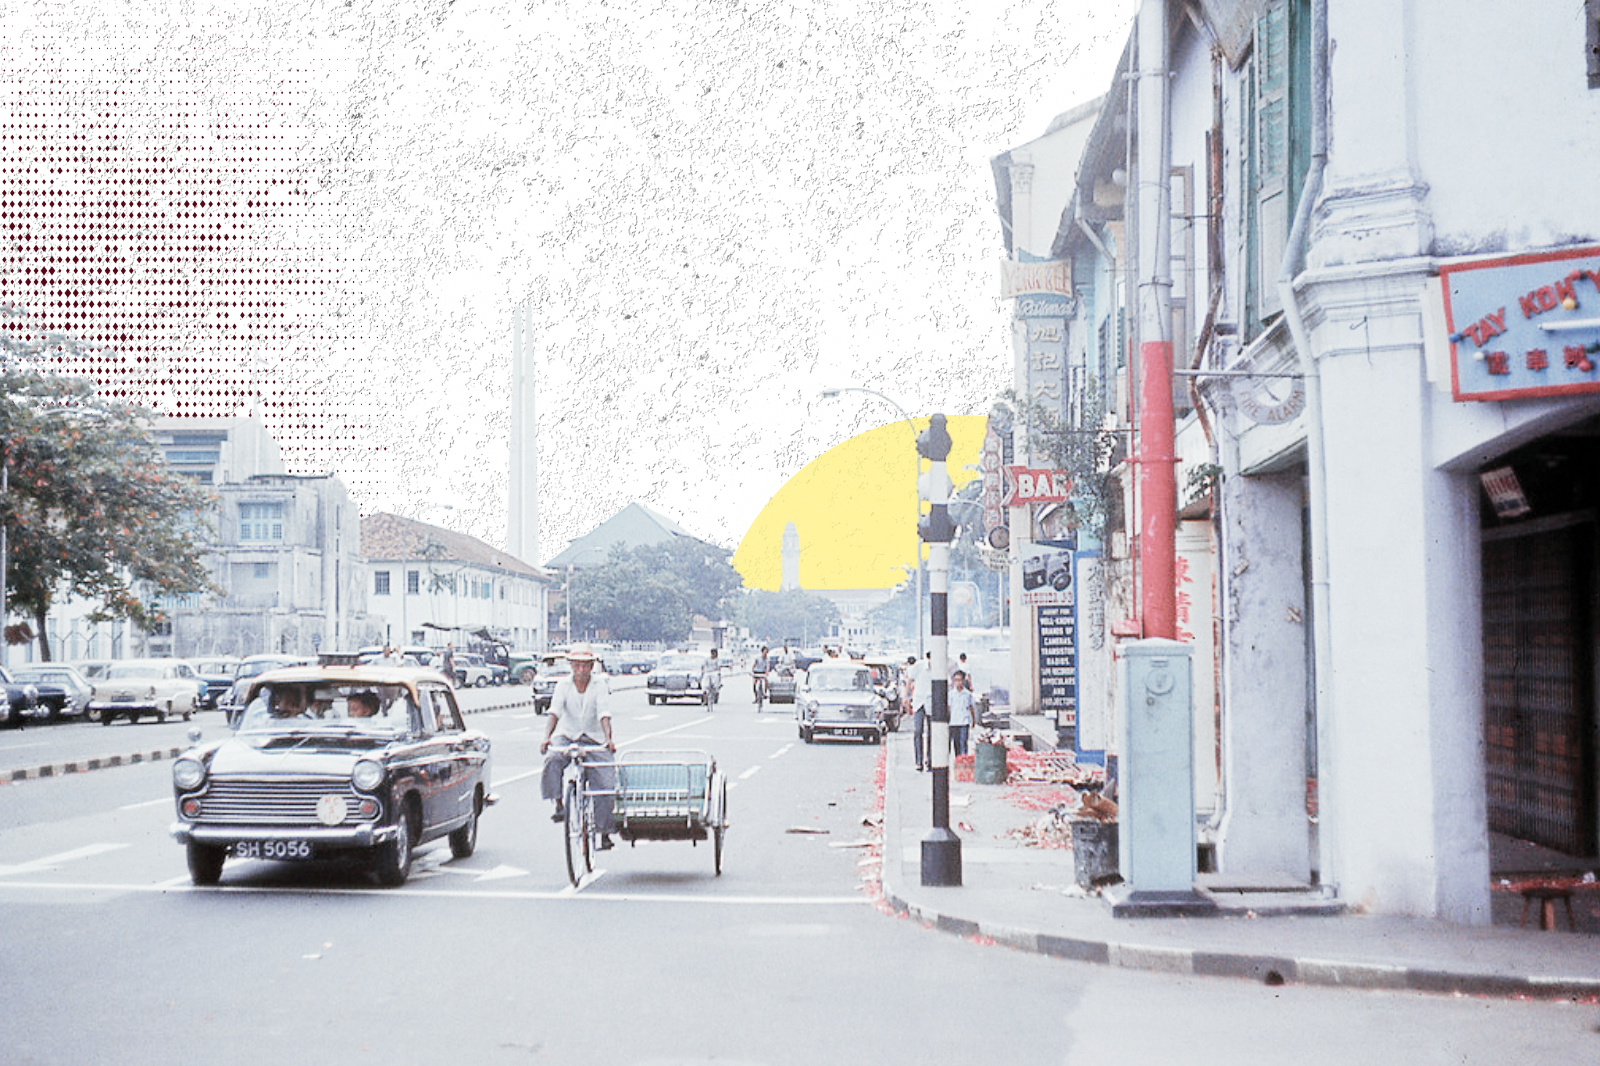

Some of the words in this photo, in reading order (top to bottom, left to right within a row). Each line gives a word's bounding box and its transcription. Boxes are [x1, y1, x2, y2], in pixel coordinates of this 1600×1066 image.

[1464, 306, 1507, 347] TAY
[1267, 389, 1304, 421] ALARM
[1018, 474, 1067, 498] BAR
[1053, 687, 1065, 695] AND
[236, 841, 259, 857] SH
[264, 840, 310, 857] 5056
